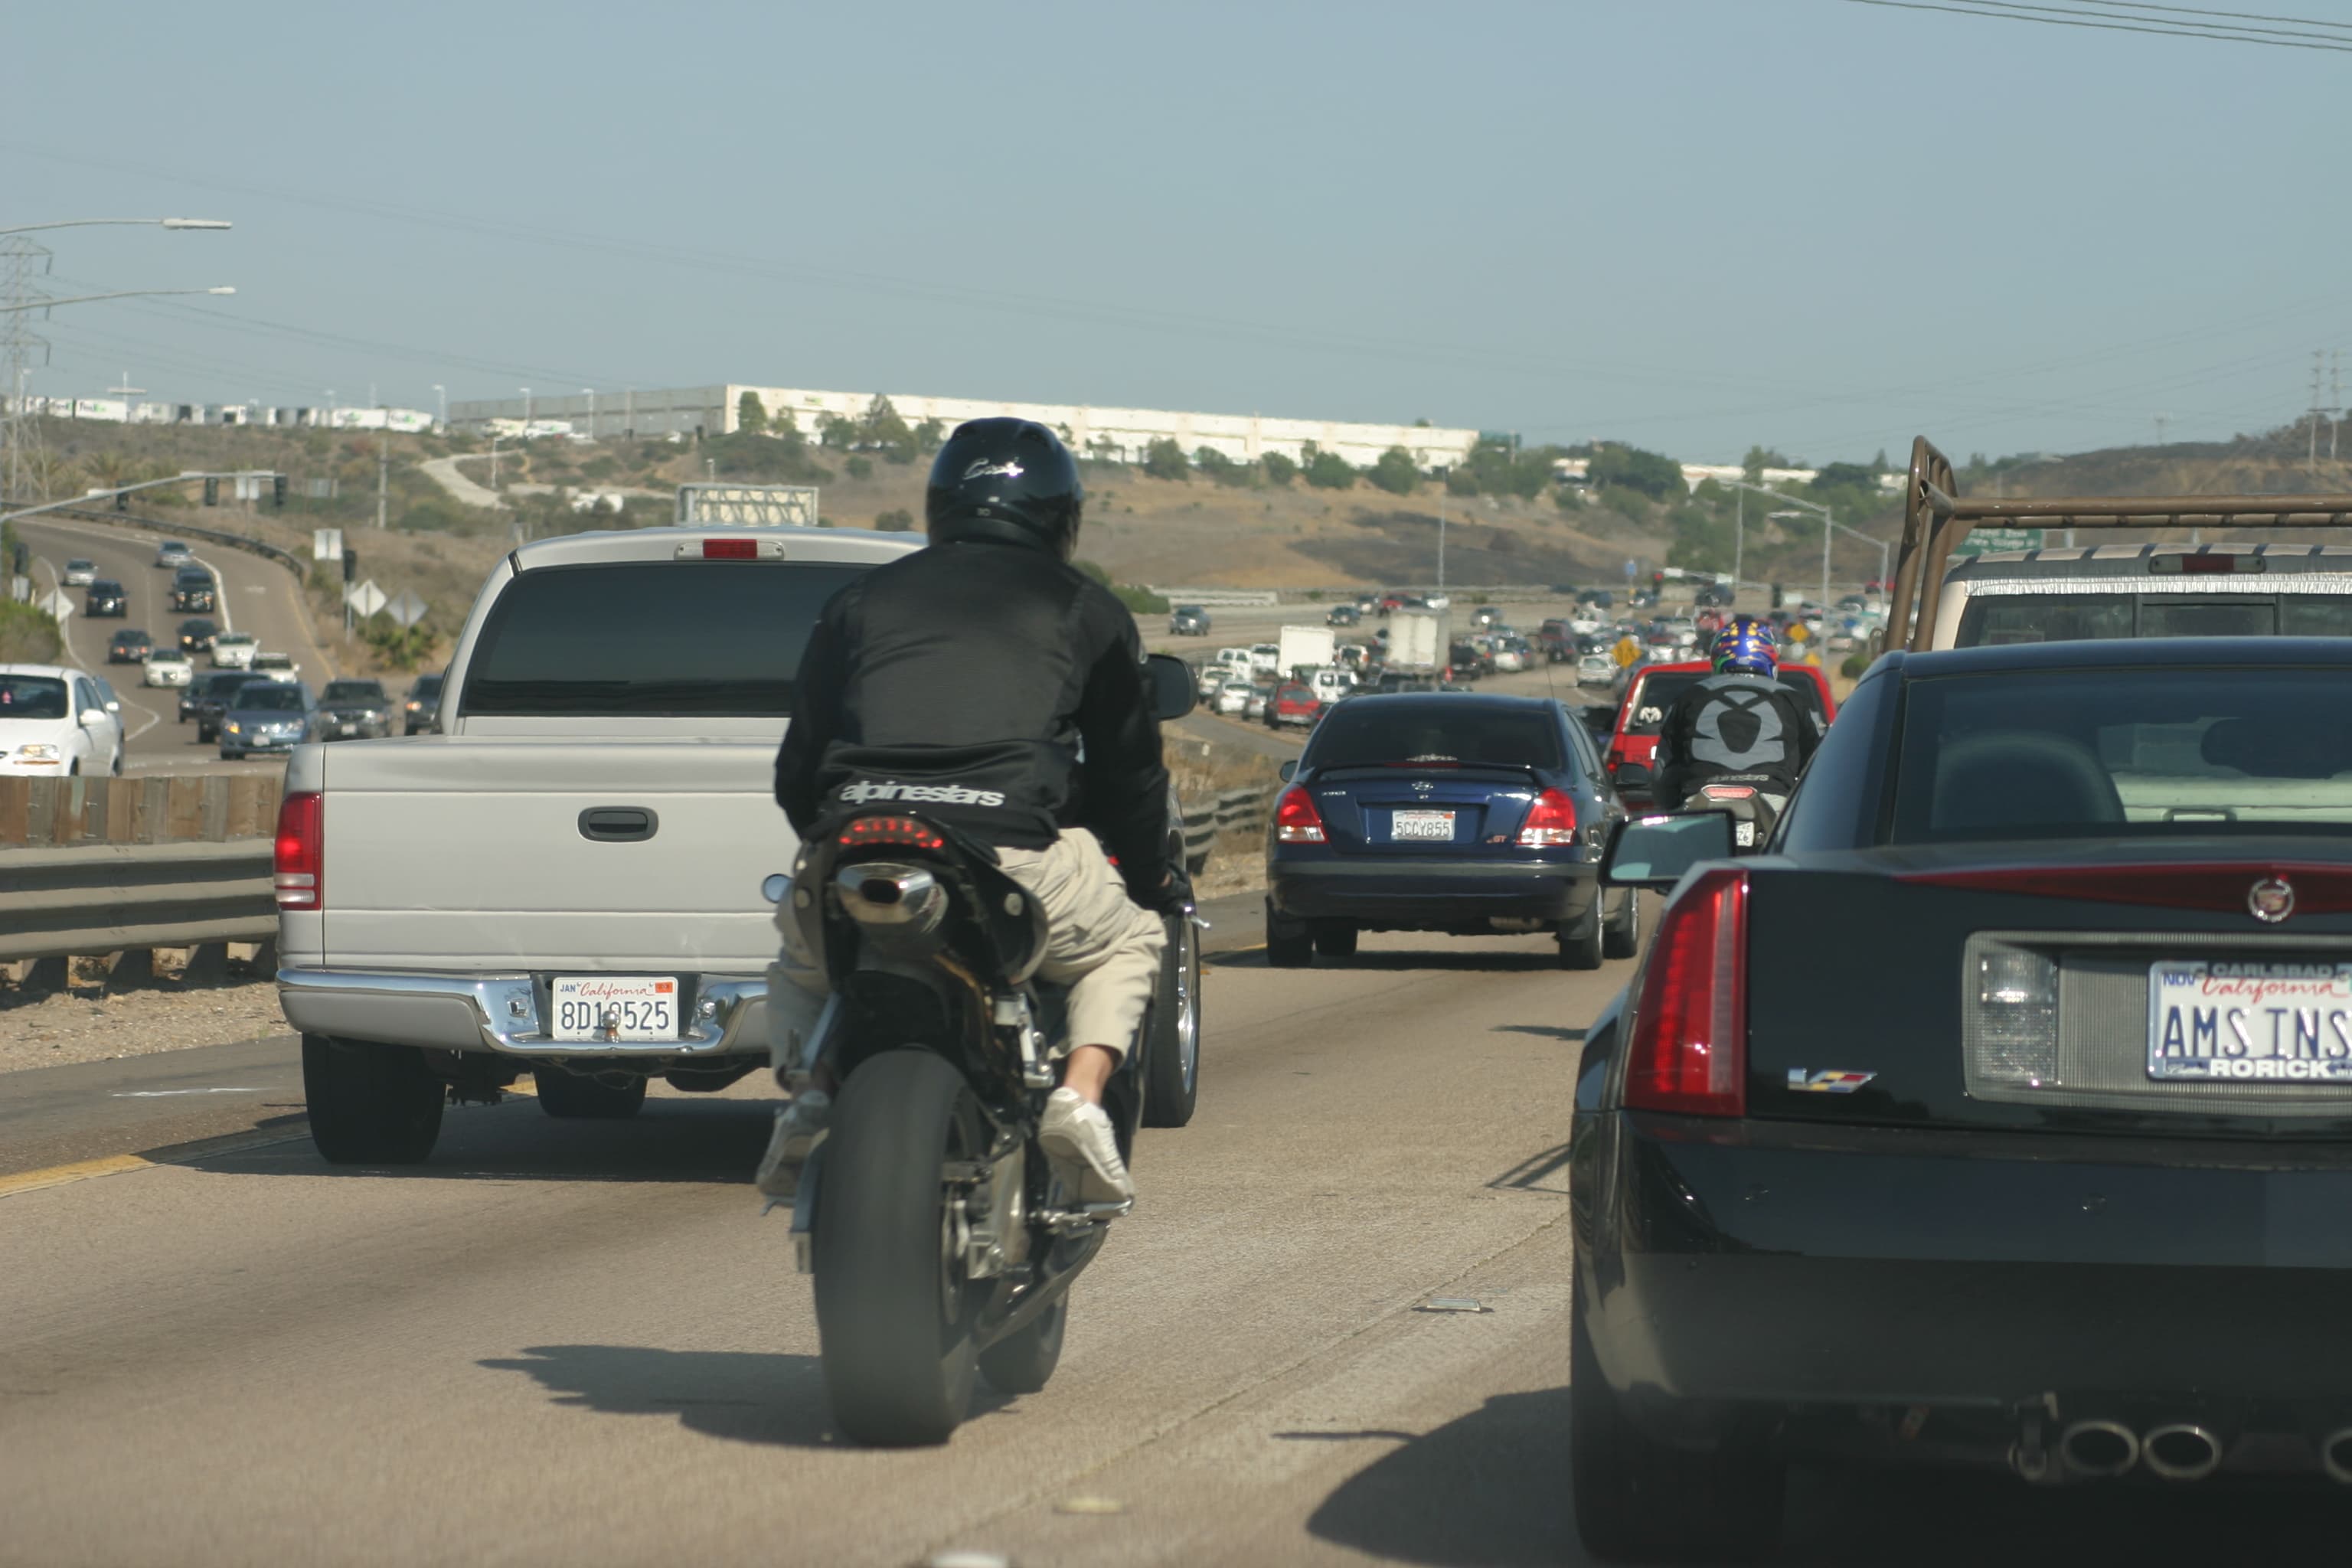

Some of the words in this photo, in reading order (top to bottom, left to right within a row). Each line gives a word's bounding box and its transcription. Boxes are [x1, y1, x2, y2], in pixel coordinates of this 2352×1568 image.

[840, 779, 1005, 806] alpinestars
[560, 984, 576, 992] JAN
[580, 982, 655, 1000] California
[2202, 976, 2350, 1004] California
[2162, 1005, 2252, 1058] AMS
[2210, 1059, 2332, 1078] RORICK
